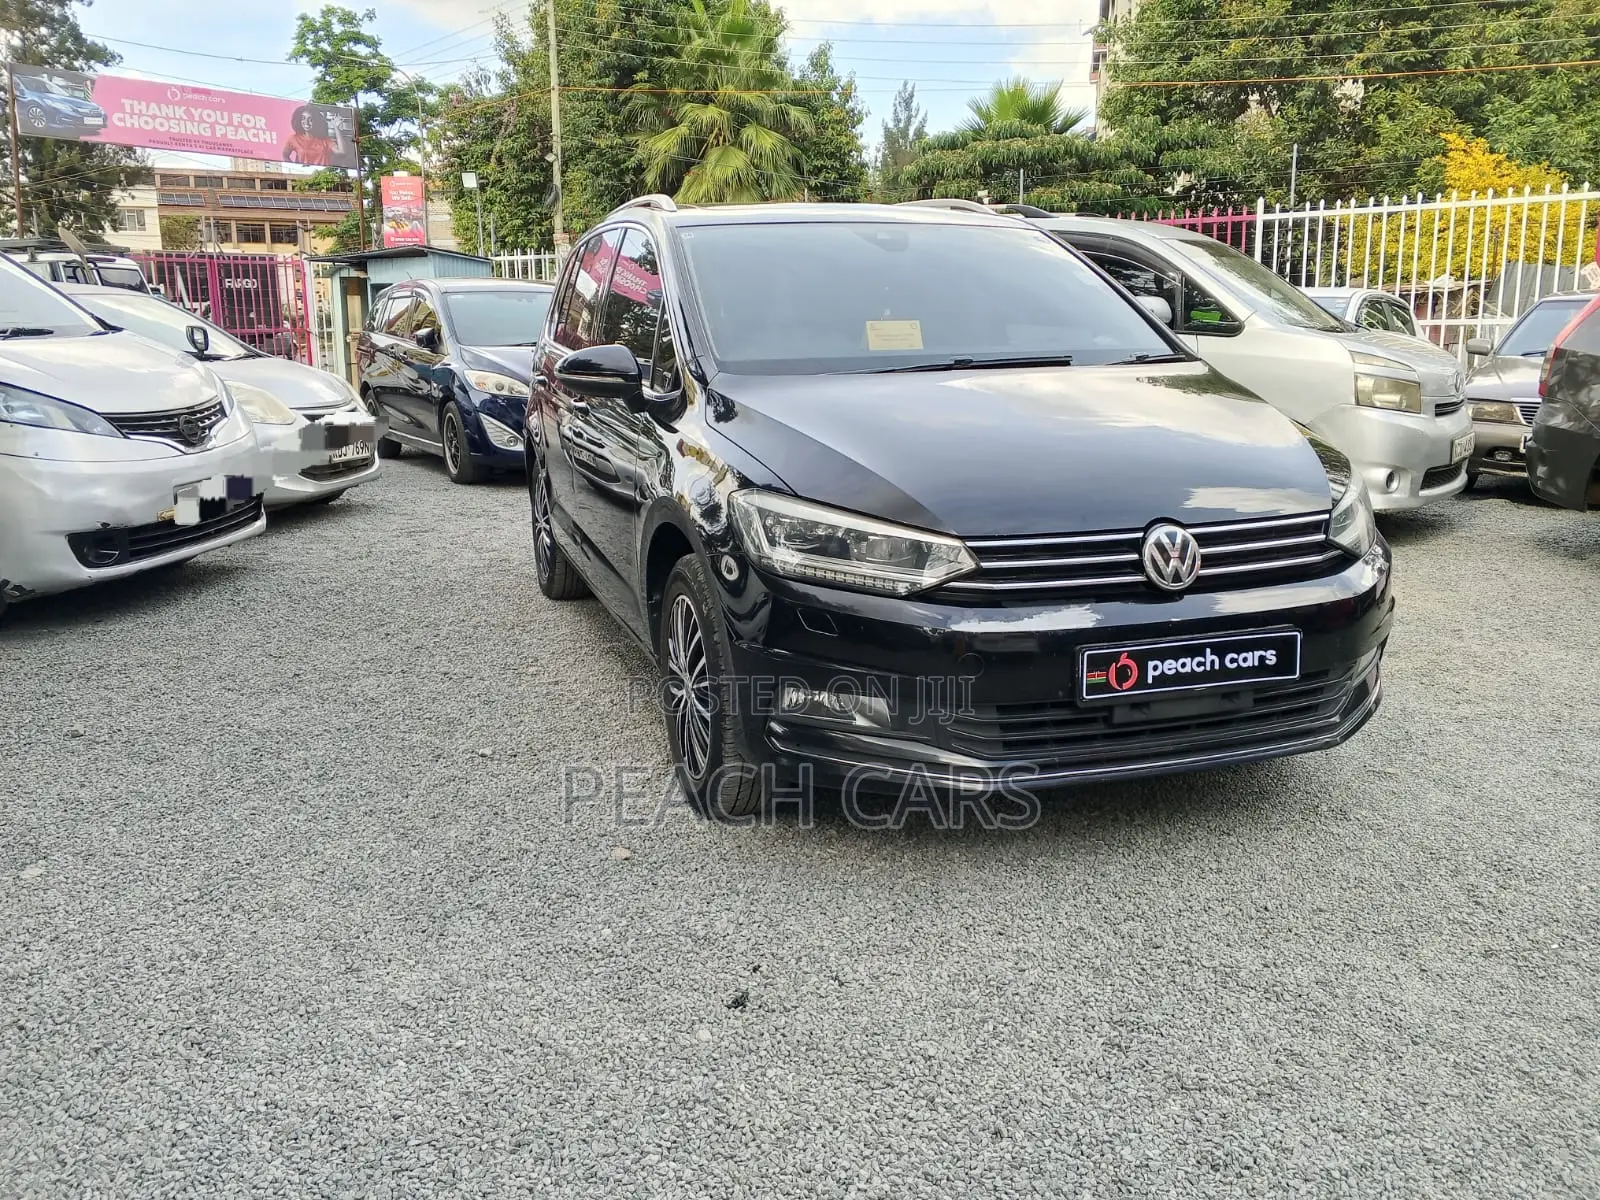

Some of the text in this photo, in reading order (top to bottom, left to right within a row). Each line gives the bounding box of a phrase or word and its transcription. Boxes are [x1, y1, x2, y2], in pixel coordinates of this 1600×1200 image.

[112, 112, 277, 145] CHOOSING PEACH!
[121, 99, 266, 129] THANK YOU FOR
[1144, 524, 1200, 589] VW
[1147, 648, 1277, 684] peach cars
